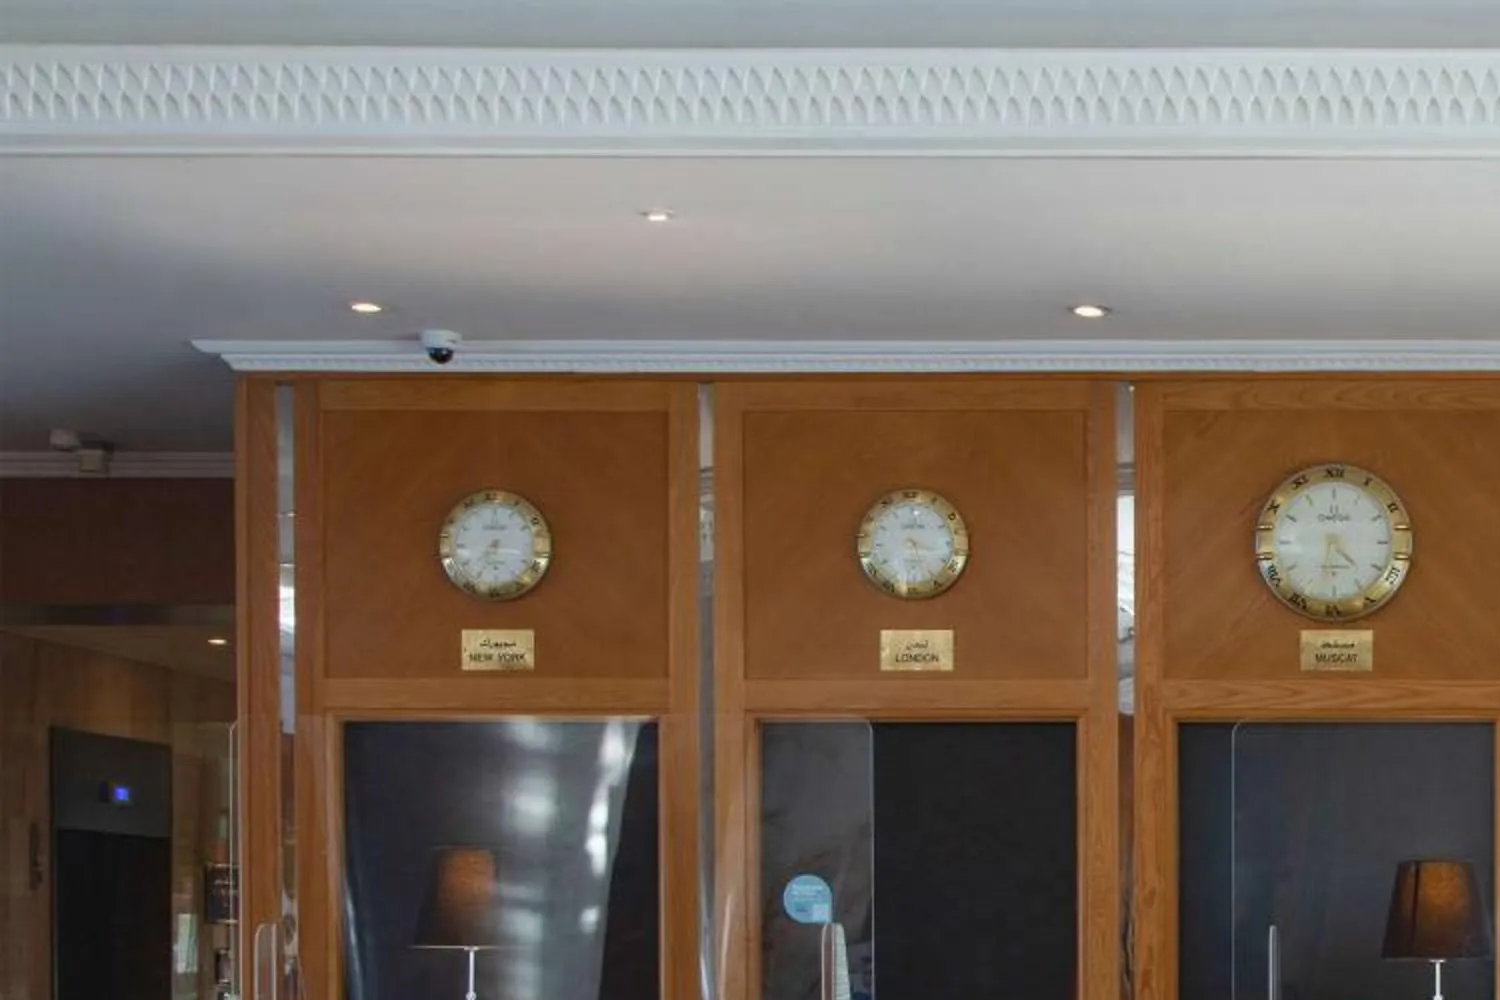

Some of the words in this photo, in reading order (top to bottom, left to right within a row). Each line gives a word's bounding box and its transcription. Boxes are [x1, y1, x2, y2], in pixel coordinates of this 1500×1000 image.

[469, 652, 493, 662] NEW
[498, 652, 525, 662] YORK
[895, 652, 939, 663] LONDON
[1315, 652, 1358, 663] MUSCAT
